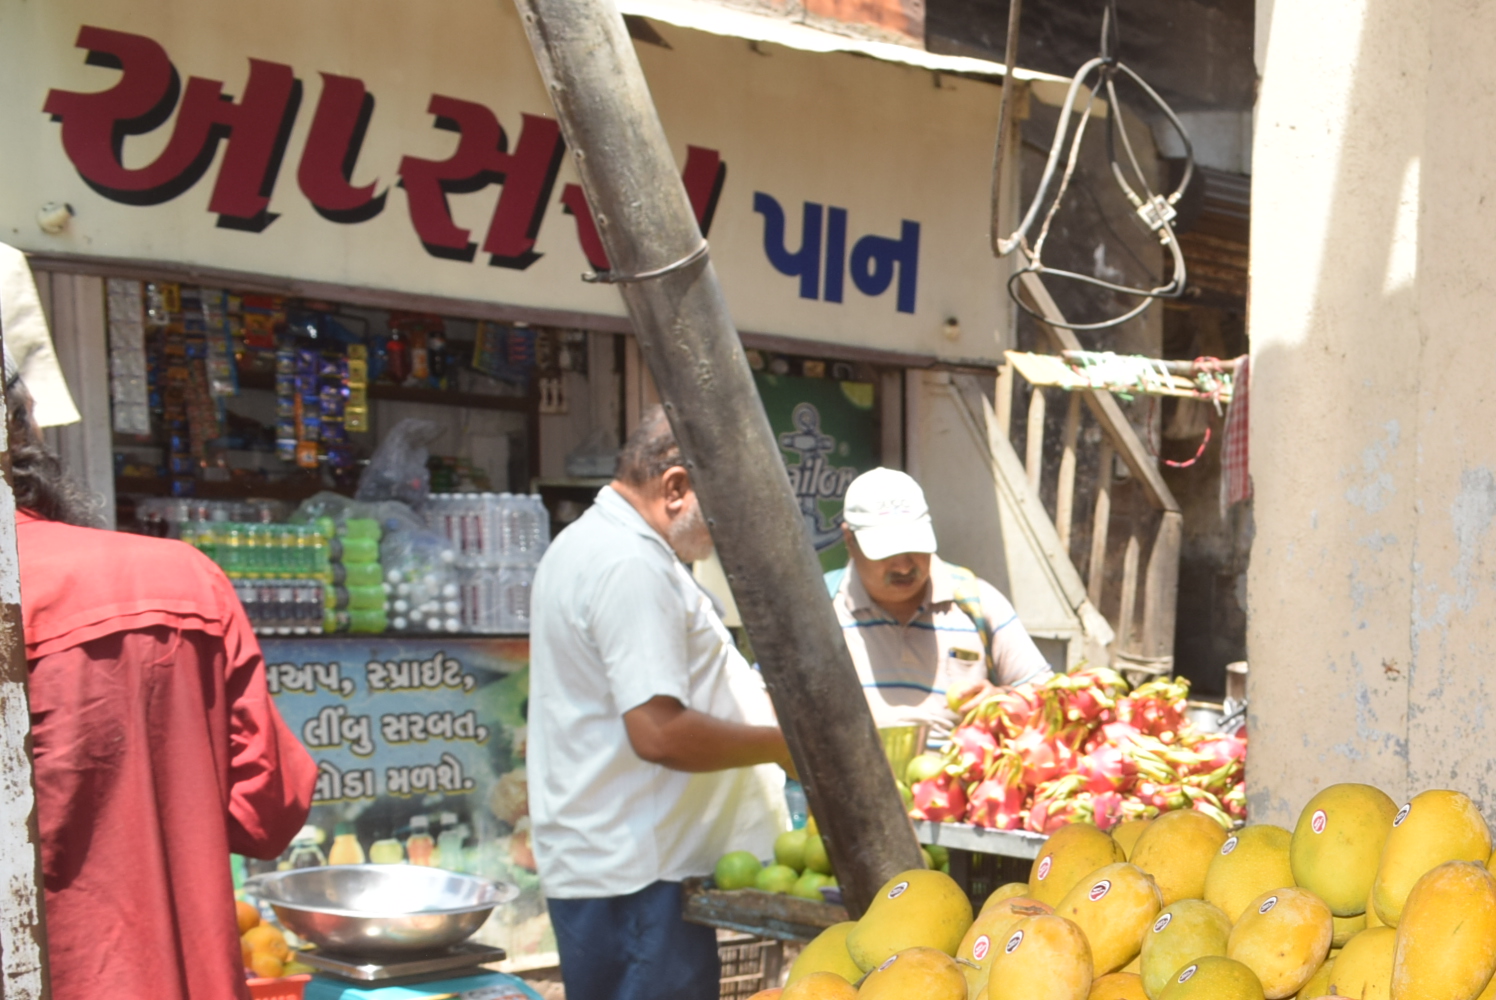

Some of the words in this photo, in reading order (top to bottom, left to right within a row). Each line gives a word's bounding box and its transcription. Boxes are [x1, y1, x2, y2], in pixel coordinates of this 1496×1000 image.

[42, 24, 728, 272] અપ્સા
[752, 190, 921, 315] પાન
[787, 457, 853, 497] ailor
[303, 704, 376, 756] લીંબુ
[381, 709, 489, 744] સરબત,
[387, 752, 475, 795] મળશે.
